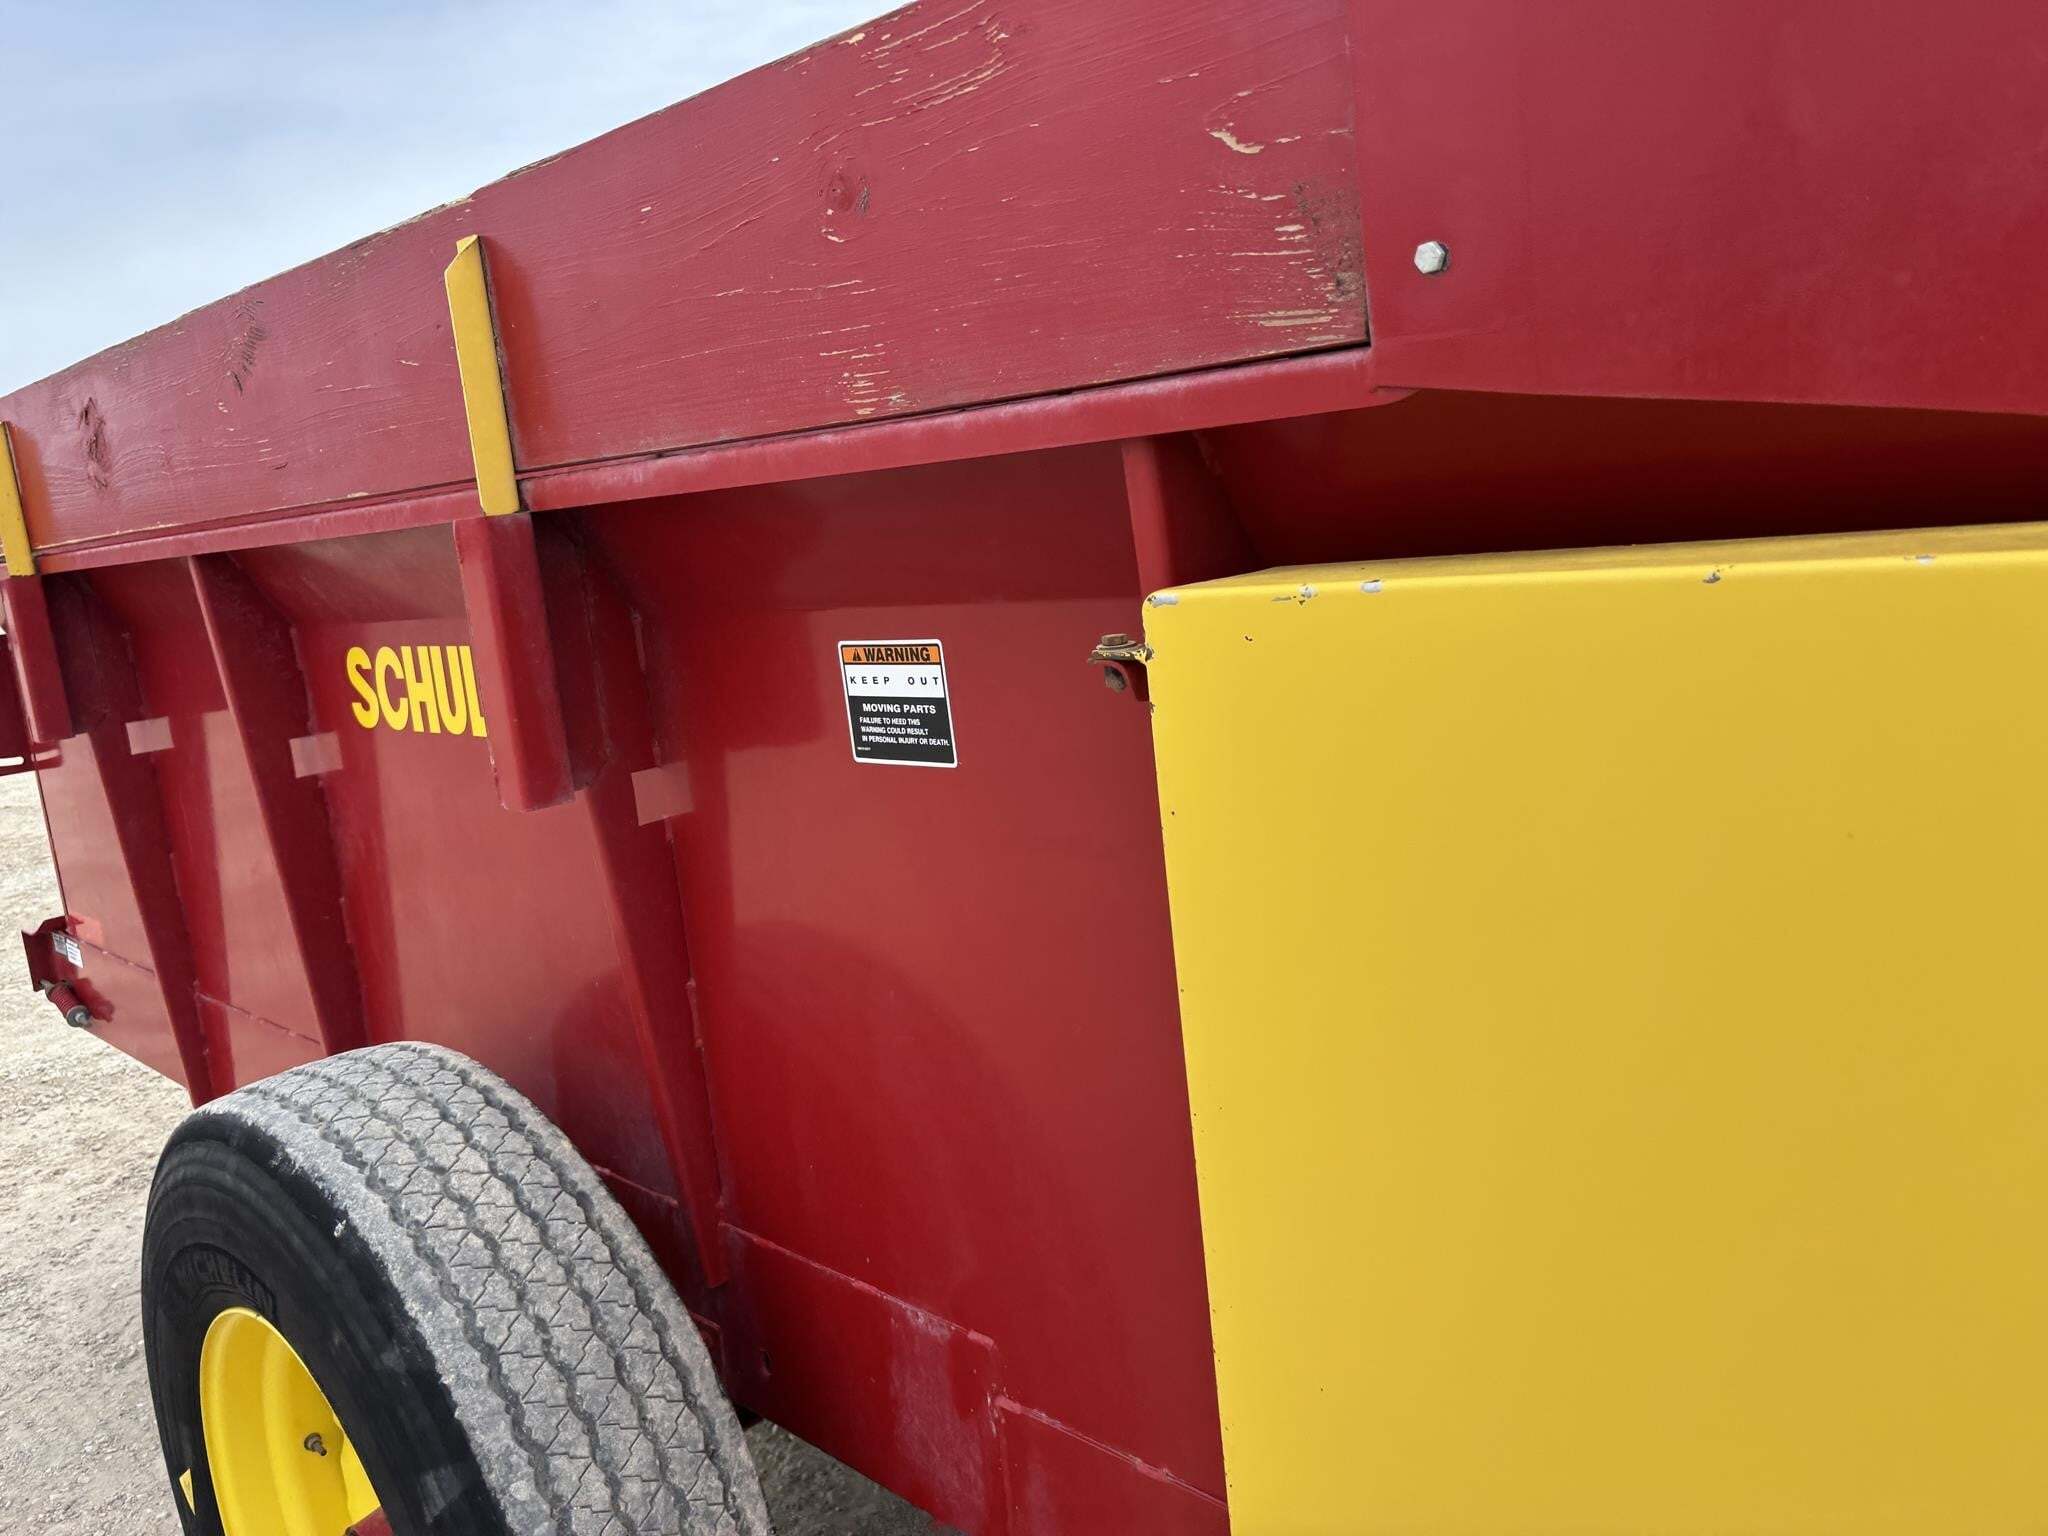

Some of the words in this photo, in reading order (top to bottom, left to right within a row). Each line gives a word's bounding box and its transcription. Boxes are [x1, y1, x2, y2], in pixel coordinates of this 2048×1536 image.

[863, 647, 931, 662] WARNING
[850, 676, 890, 685] KEEP
[907, 676, 938, 685] OUT
[346, 645, 487, 738] SCHUL
[862, 703, 901, 713] MOVING
[903, 704, 937, 714] PARTS
[859, 717, 882, 725] FAILURE
[882, 717, 891, 725] TO
[907, 718, 921, 726] THIS
[861, 726, 886, 734] WARNING
[886, 727, 906, 735] COULD
[868, 735, 897, 744] PERSONAL
[929, 738, 950, 746] DEATH.
